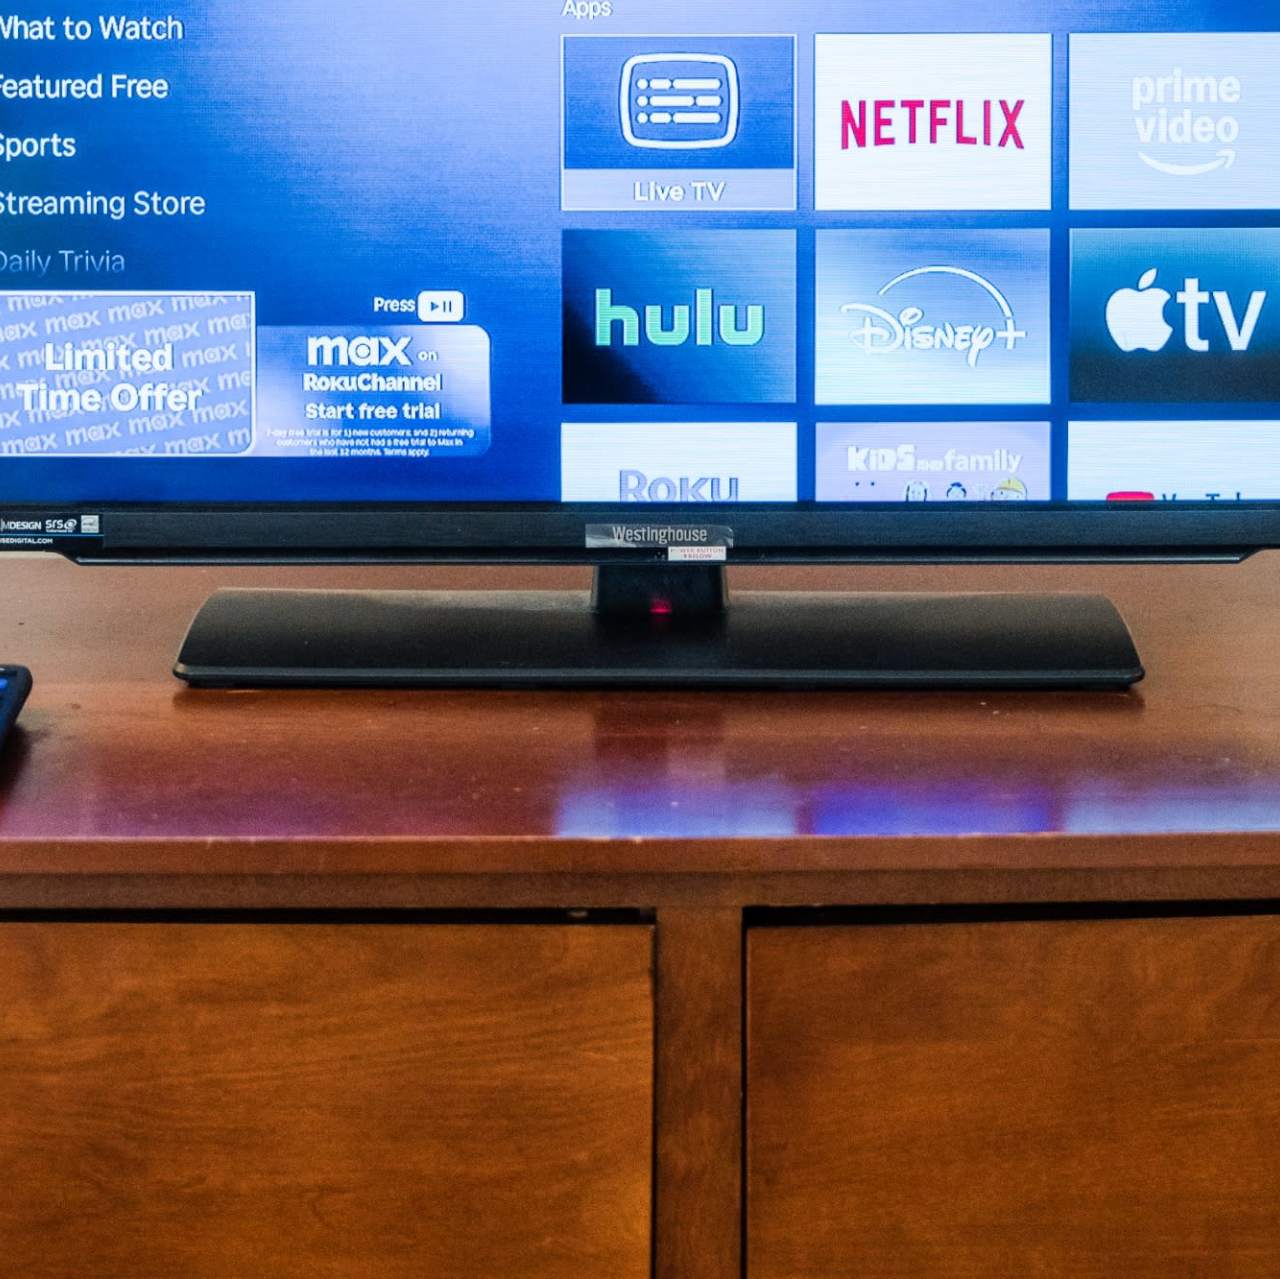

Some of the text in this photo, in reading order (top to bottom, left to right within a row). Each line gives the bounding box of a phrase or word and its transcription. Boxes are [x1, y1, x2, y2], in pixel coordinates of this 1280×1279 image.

[63, 19, 91, 40] to
[99, 16, 183, 40] Watch
[111, 75, 168, 98] Free
[1132, 69, 1242, 109] prime
[841, 99, 1025, 150] NETFLIX
[1134, 108, 1240, 144] video
[133, 191, 206, 215] Store
[634, 181, 726, 203] Live TV
[59, 250, 125, 274] Trivia
[374, 297, 416, 312] Press
[1176, 277, 1266, 352] tv
[45, 309, 102, 335] max
[108, 299, 165, 324] max
[144, 321, 200, 346] max
[207, 312, 251, 335] ma
[595, 288, 765, 346] hulu
[44, 342, 173, 371] Limited
[182, 344, 237, 368] max
[308, 336, 438, 366] max on
[217, 370, 251, 391] ma
[17, 383, 102, 412] Time
[110, 383, 203, 412] Offer
[306, 403, 440, 420] Start free trial
[1, 432, 58, 454] max
[65, 422, 122, 447] max
[128, 411, 185, 435] max
[192, 400, 248, 424] max
[439, 429, 474, 437] returning
[164, 433, 221, 454] max
[394, 439, 409, 447] free
[427, 439, 436, 447] to
[943, 448, 1022, 473] family
[619, 470, 738, 502] Roku
[612, 526, 707, 544] Westinghouse
